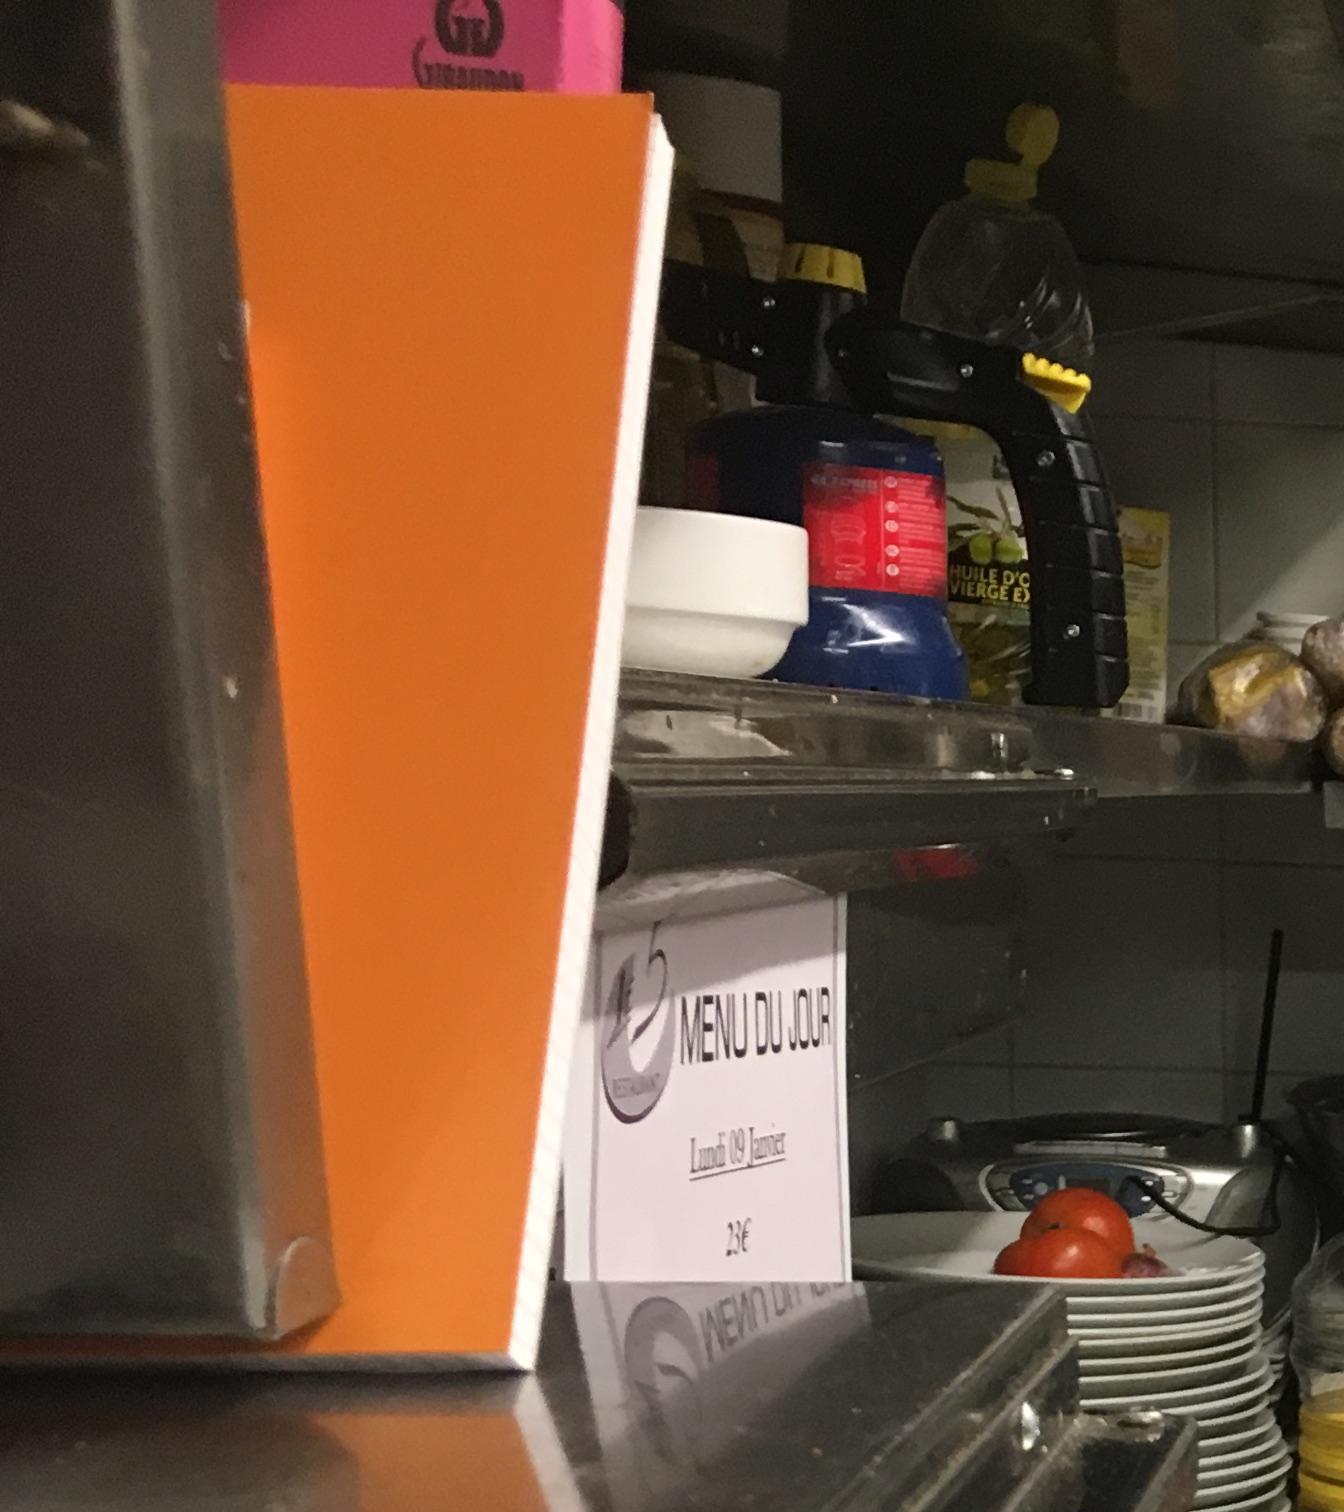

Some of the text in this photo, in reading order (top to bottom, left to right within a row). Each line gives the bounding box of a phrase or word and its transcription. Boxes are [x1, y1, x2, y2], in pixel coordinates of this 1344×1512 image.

[950, 564, 998, 584] HUILE
[950, 581, 1009, 600] VIERGE
[680, 986, 831, 1065] MENU DU JOUR
[690, 1122, 787, 1173] Lundi 09 Janvier
[725, 1217, 752, 1257] 23€
